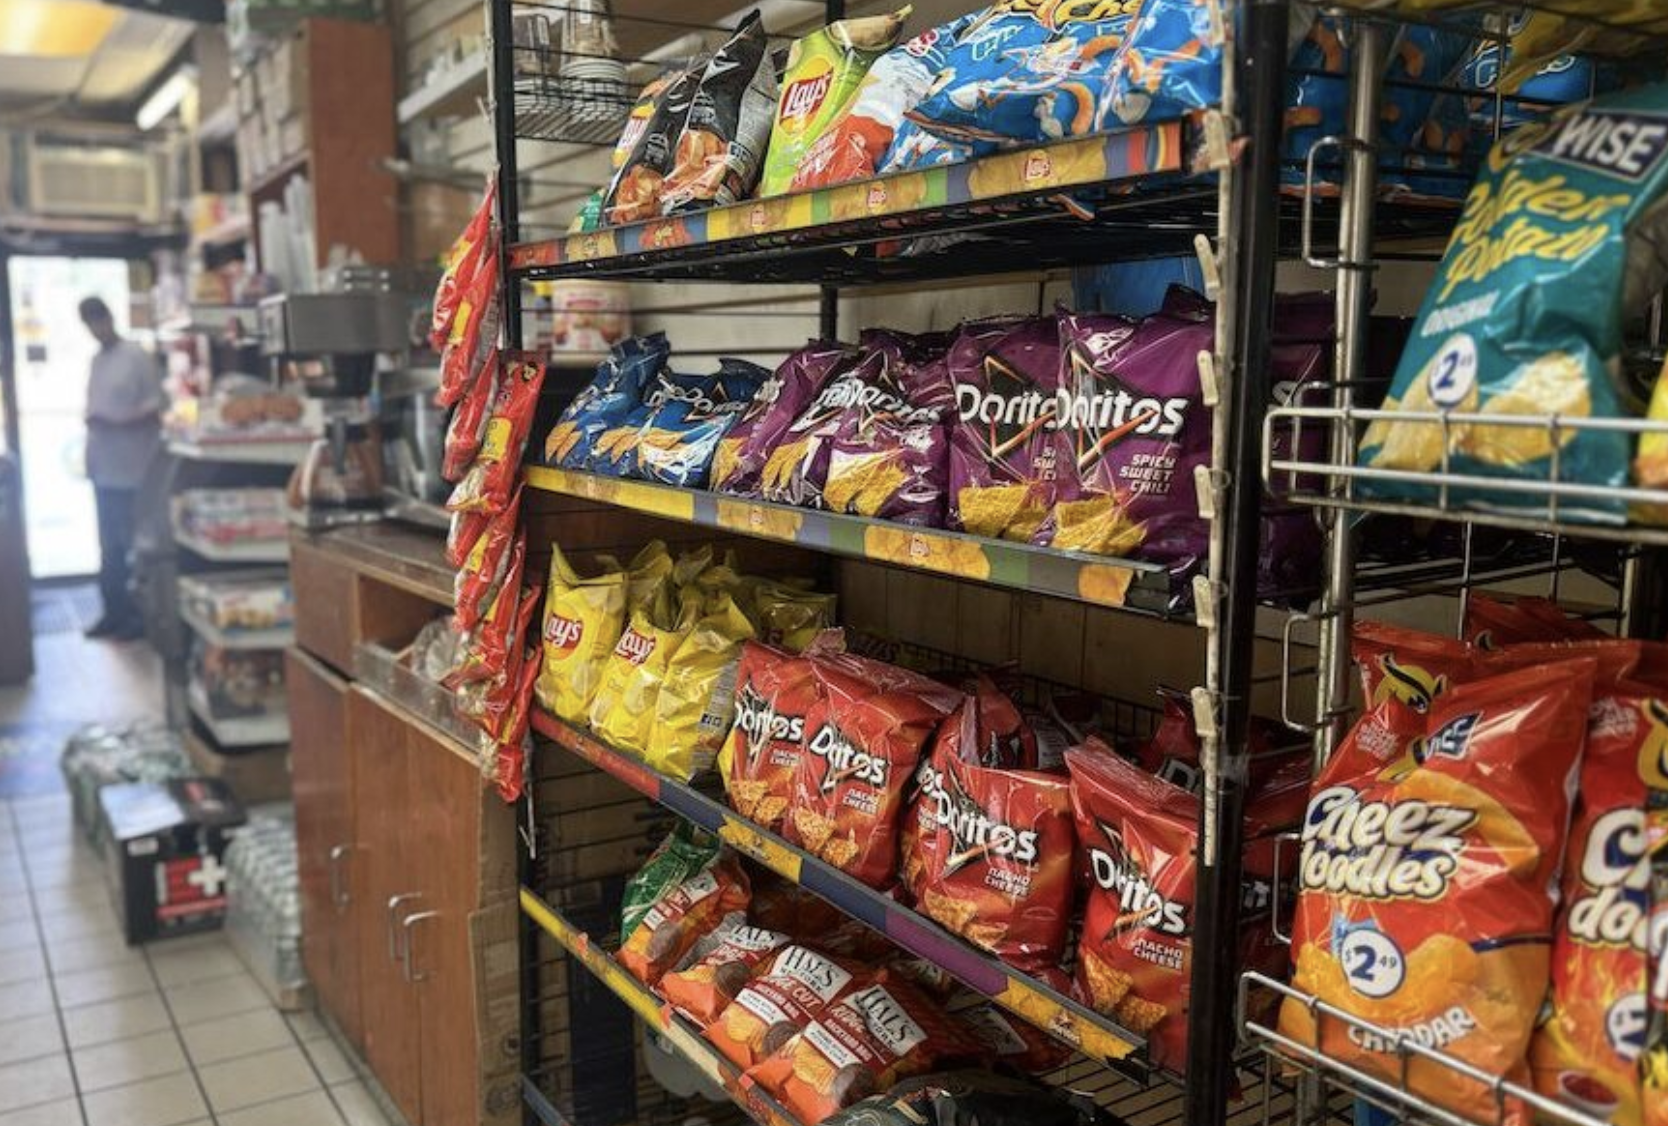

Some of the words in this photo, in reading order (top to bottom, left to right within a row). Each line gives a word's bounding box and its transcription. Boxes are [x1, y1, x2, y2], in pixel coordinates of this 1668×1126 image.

[1551, 114, 1667, 173] WISE
[1436, 350, 1460, 390] 2
[956, 384, 1057, 428] Dorito
[1055, 388, 1189, 435] Doritos
[1119, 466, 1174, 480] SWEET
[1131, 453, 1177, 469] SPICY
[1129, 480, 1171, 494] CHILI
[936, 789, 1039, 861] Doritos
[1301, 786, 1475, 852] Cheez
[784, 944, 833, 988] HAL'S
[1133, 946, 1183, 970] CHEESE
[1136, 937, 1183, 959] NACHO
[791, 984, 823, 1009] CUT
[857, 986, 914, 1043] HAL'S
